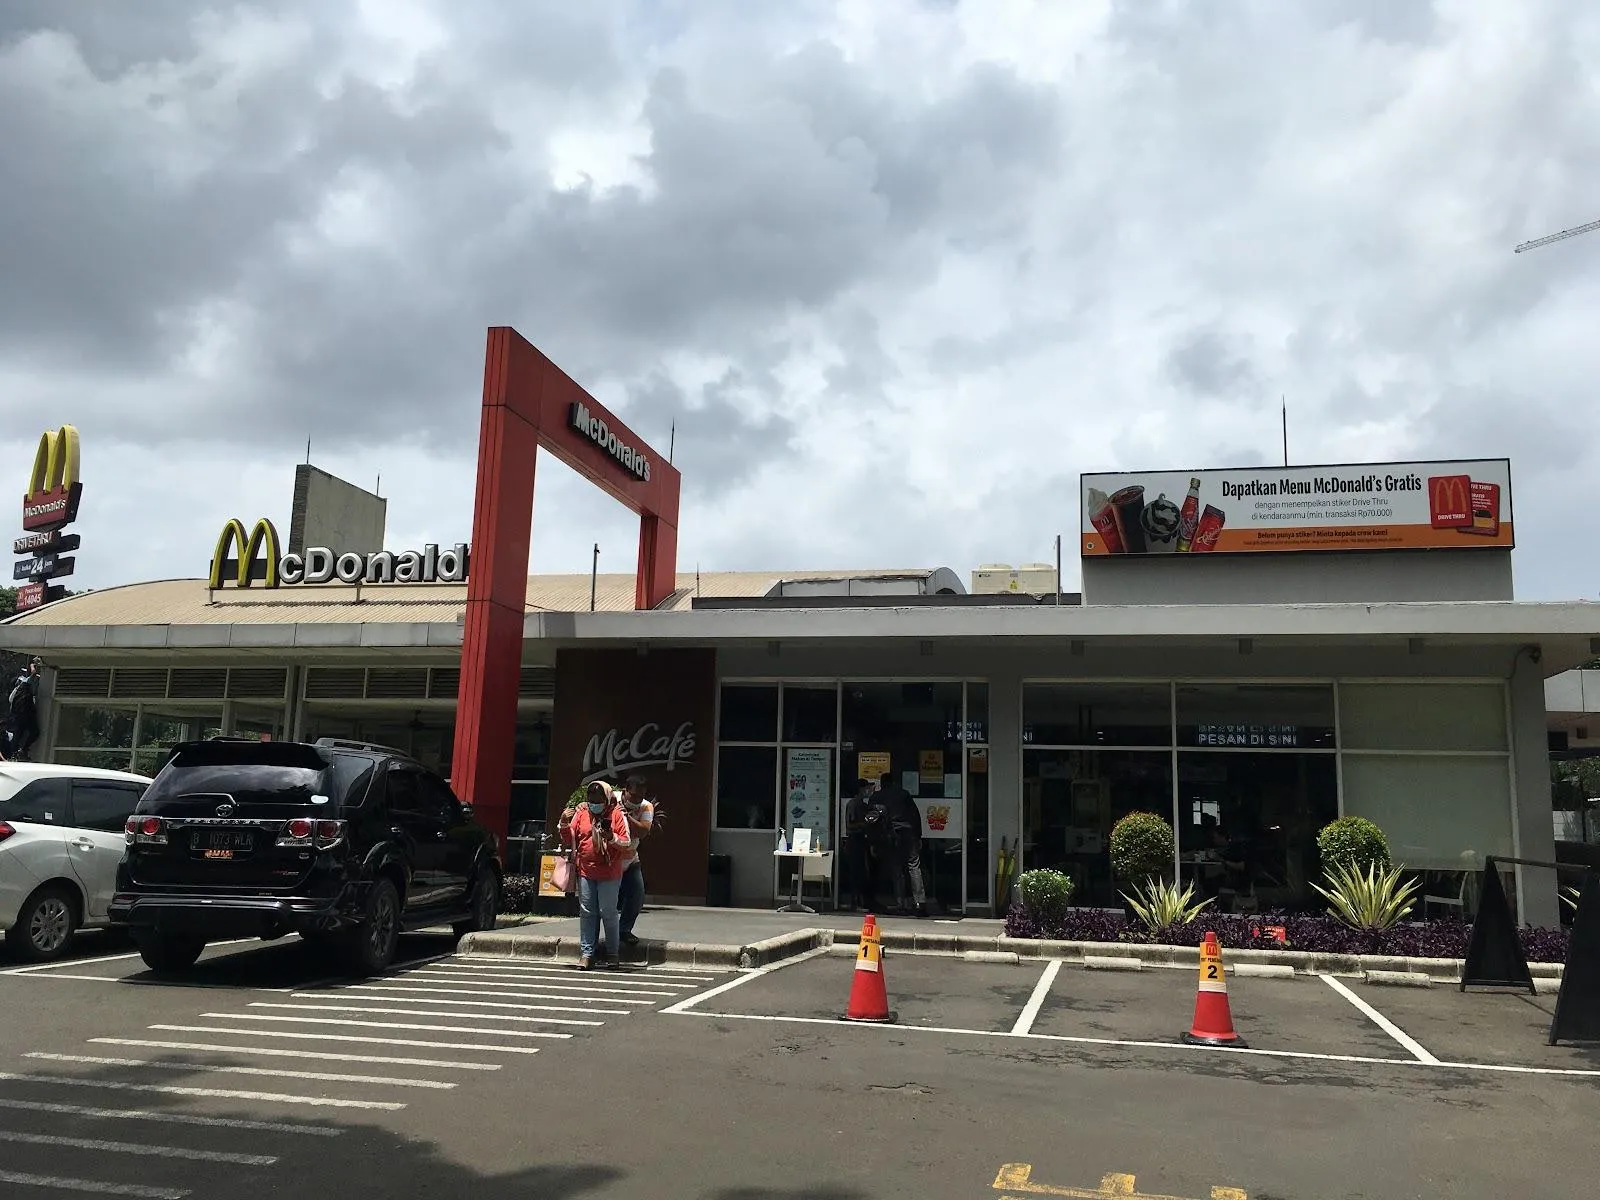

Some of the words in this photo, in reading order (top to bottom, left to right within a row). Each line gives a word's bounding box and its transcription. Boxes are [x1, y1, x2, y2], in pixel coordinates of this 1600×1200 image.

[574, 401, 651, 482] McDonald's
[1222, 479, 1277, 500] Dapatkan
[1279, 478, 1311, 495] Menu
[1313, 475, 1382, 494] McDonald's
[1384, 473, 1422, 492] Gratis
[24, 499, 66, 518] McDonald's
[1254, 500, 1280, 510] dengan
[1281, 500, 1331, 510] menempelkan
[1332, 499, 1351, 507] stiker
[1352, 498, 1371, 506] Drive
[1372, 497, 1389, 505] Thru
[1259, 511, 1306, 520] kendaraanmu
[1325, 510, 1357, 518] transaksi
[30, 558, 44, 575] 24
[1198, 733, 1246, 745] PESAN
[1250, 734, 1264, 744] DI
[1268, 734, 1297, 745] SINI
[582, 721, 696, 779] McCafé
[862, 945, 869, 958] 1
[1207, 964, 1218, 979] 2
